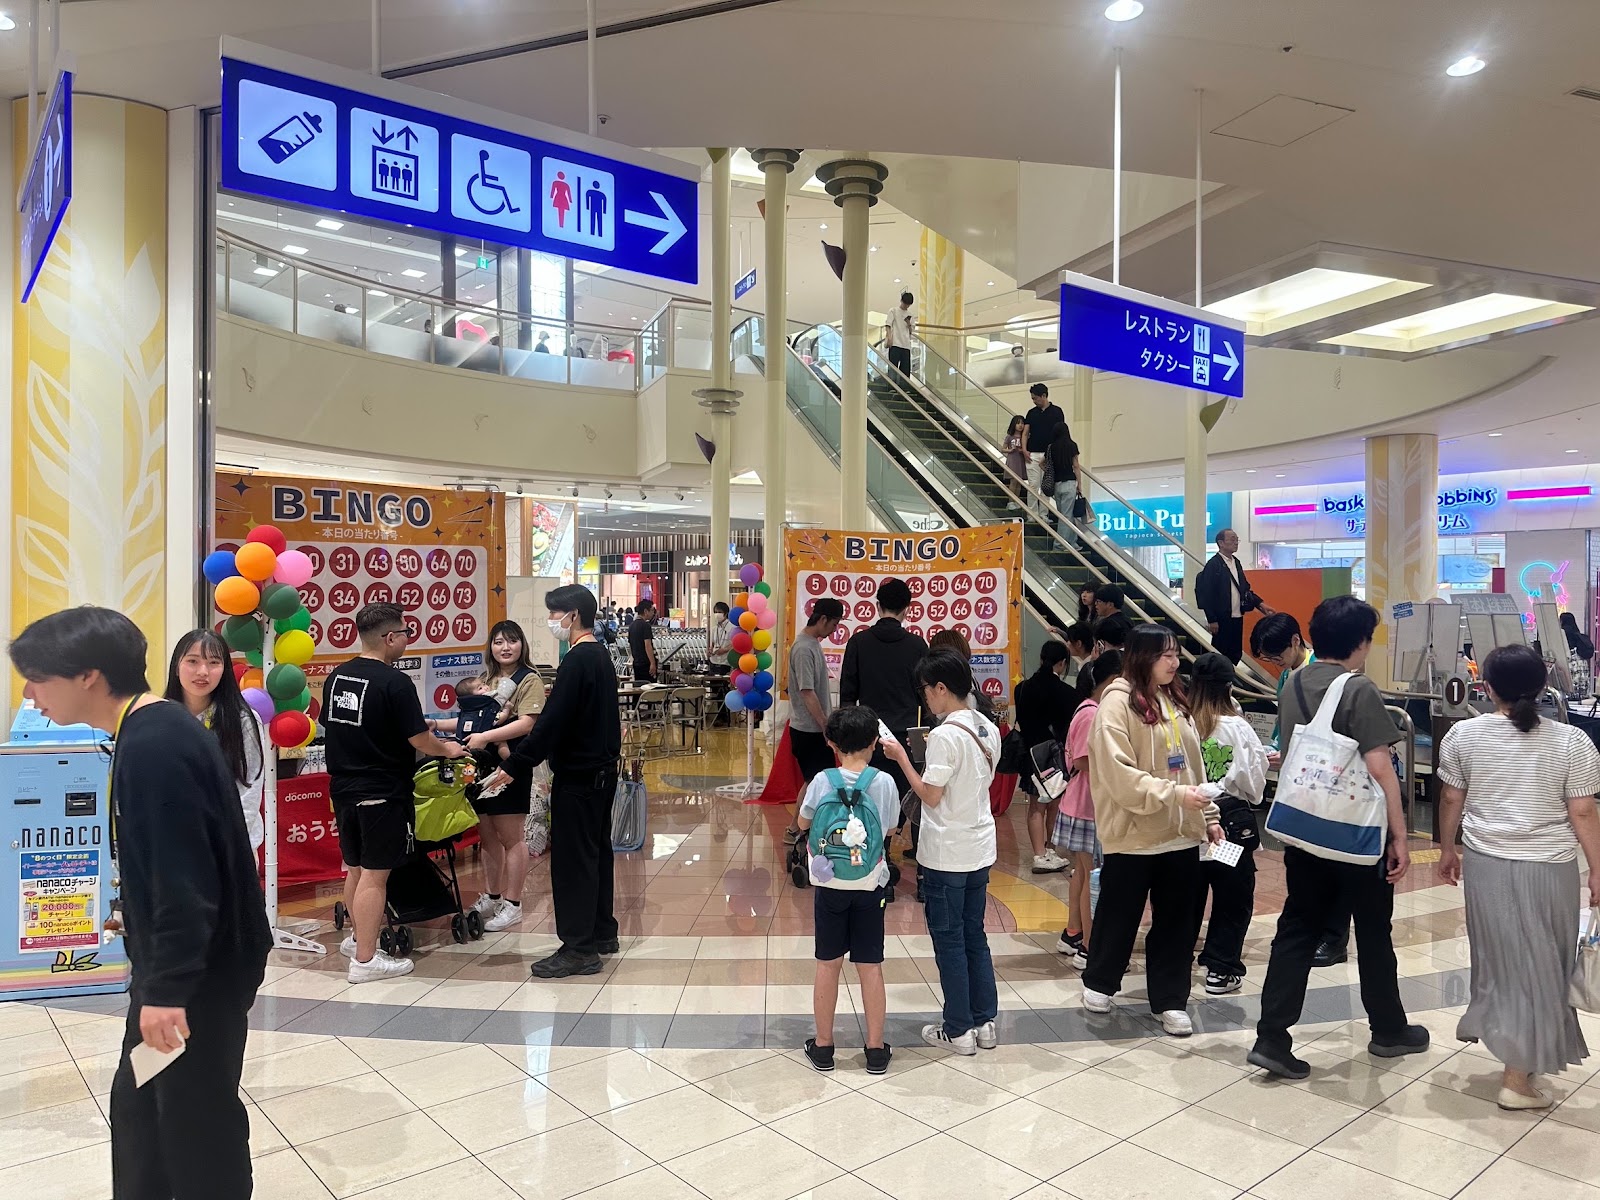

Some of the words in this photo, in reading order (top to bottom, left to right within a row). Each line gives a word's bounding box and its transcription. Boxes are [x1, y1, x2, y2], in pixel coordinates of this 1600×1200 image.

[1125, 309, 1191, 344] レストラン
[1140, 347, 1191, 373] タクシー
[1195, 356, 1208, 367] TAXI
[273, 486, 432, 528] BINGO
[1324, 494, 1365, 512] bask
[1437, 488, 1495, 507] obbins
[1096, 509, 1147, 532] Bull
[846, 536, 960, 561] BINGO
[336, 553, 353, 571] 31
[368, 554, 389, 571] 43
[399, 555, 419, 572] 50
[430, 555, 448, 571] 64
[458, 555, 473, 571] 70
[685, 555, 709, 566] とんかつ
[811, 578, 820, 591] 5
[834, 579, 848, 592] 10
[858, 580, 874, 593] 20
[908, 581, 922, 593] 43
[930, 580, 946, 593] 50
[954, 578, 969, 591] 64
[978, 576, 994, 589] 70
[299, 589, 319, 607] 26
[333, 589, 356, 607] 34
[367, 589, 388, 604] 45
[400, 589, 420, 606] 52
[431, 588, 447, 605] 66
[456, 588, 472, 604] 73
[858, 605, 872, 618] 26
[906, 605, 921, 618] 45
[930, 605, 945, 617] 52
[953, 603, 968, 616] 66
[977, 602, 993, 615] 73
[332, 623, 353, 641] 37
[429, 619, 446, 637] 69
[455, 618, 472, 635] 75
[977, 626, 994, 640] 75
[392, 659, 421, 670] ス数字③
[971, 655, 1002, 664] ナス数字④
[342, 690, 353, 698] THE
[985, 681, 1001, 694] 44
[1452, 681, 1459, 702] 1
[440, 689, 450, 704] 4
[284, 791, 323, 803] docomo
[21, 826, 101, 848] nanaco
[36, 877, 97, 889] nanacoチャージ
